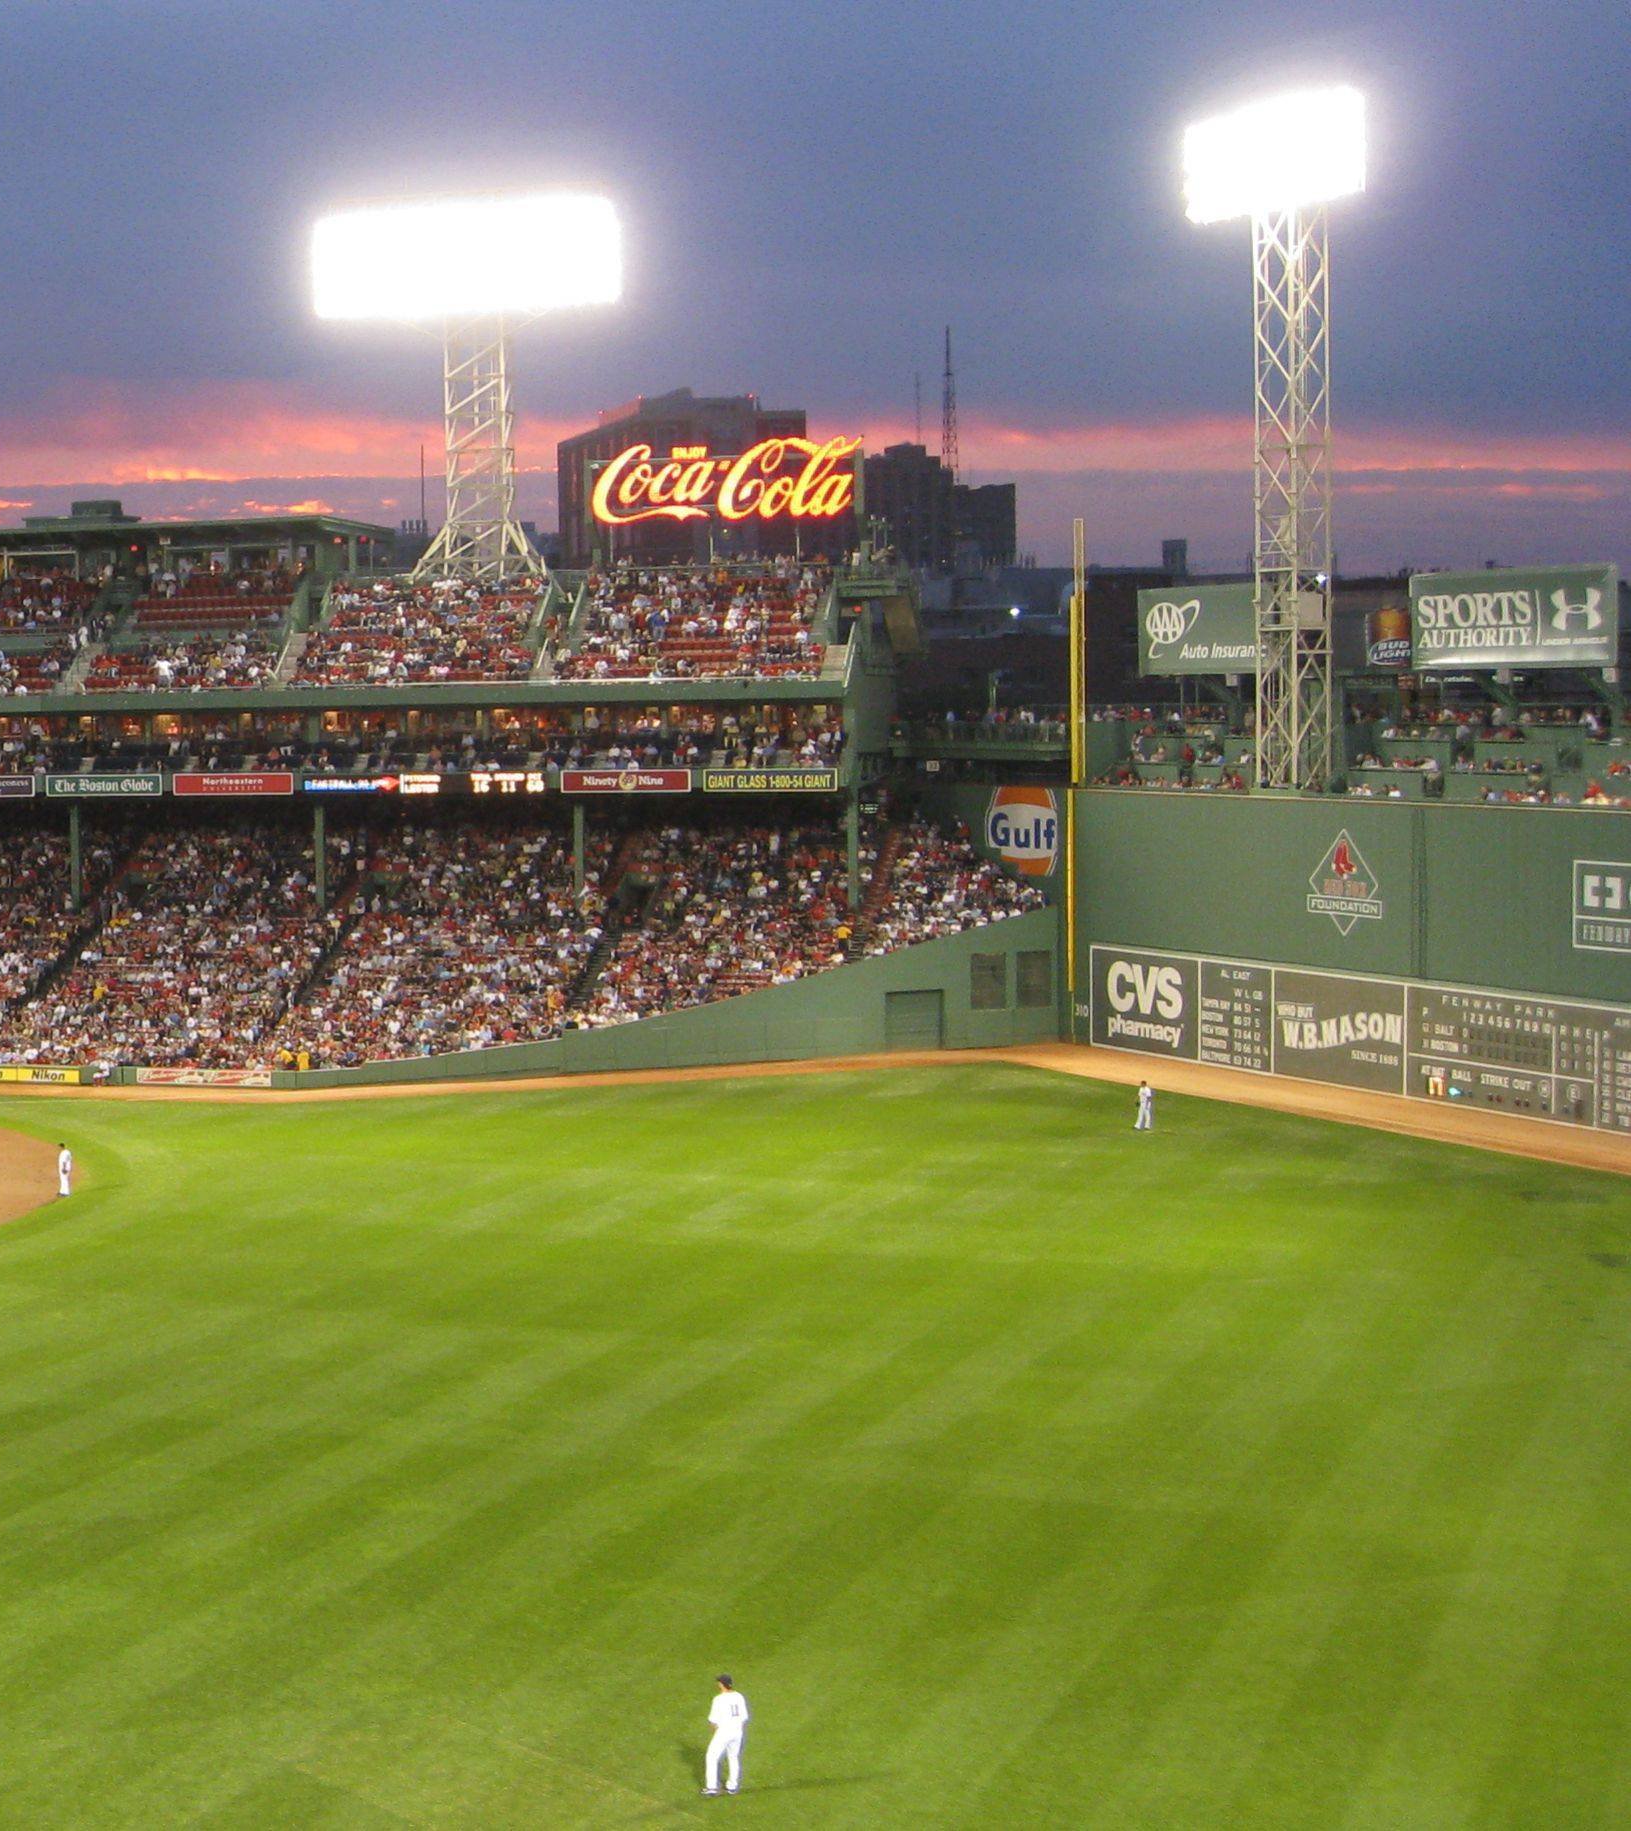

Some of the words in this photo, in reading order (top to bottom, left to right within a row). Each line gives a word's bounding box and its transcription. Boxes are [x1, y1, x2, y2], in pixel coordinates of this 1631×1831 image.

[672, 446, 708, 459] ENJOY
[592, 434, 865, 524] Coca-Cola
[1418, 590, 1532, 629] SPORTS
[1151, 604, 1182, 641] AAA
[1179, 643, 1209, 660] Auto
[1377, 640, 1410, 651] BUD
[54, 779, 76, 793] The
[78, 778, 119, 793] Boston
[120, 778, 154, 793] Globe
[202, 777, 264, 786] Northeastern
[500, 781, 517, 793] 11
[582, 775, 618, 788] Ninety
[638, 775, 664, 786] Nine
[708, 775, 735, 789] GIANT
[736, 775, 767, 789] GLASS
[804, 774, 832, 788] GIANT
[990, 812, 1057, 850] Gulf
[1311, 898, 1379, 915] FOUNDATION
[1232, 970, 1252, 981] EAST
[1107, 960, 1184, 1020] CVS
[1276, 1003, 1296, 1017] WHO
[1296, 1005, 1314, 1019] BUT
[1441, 994, 1503, 1012] FENWAY
[1513, 1003, 1555, 1019] PARK
[1107, 1013, 1182, 1049] pharmacy
[1433, 1023, 1456, 1037] BALT
[1350, 1048, 1378, 1063] SINCE
[31, 1069, 66, 1082] Nikon
[1451, 1068, 1473, 1083] BALL
[1480, 1072, 1510, 1089] STRIKE
[1511, 1077, 1533, 1092] OUT
